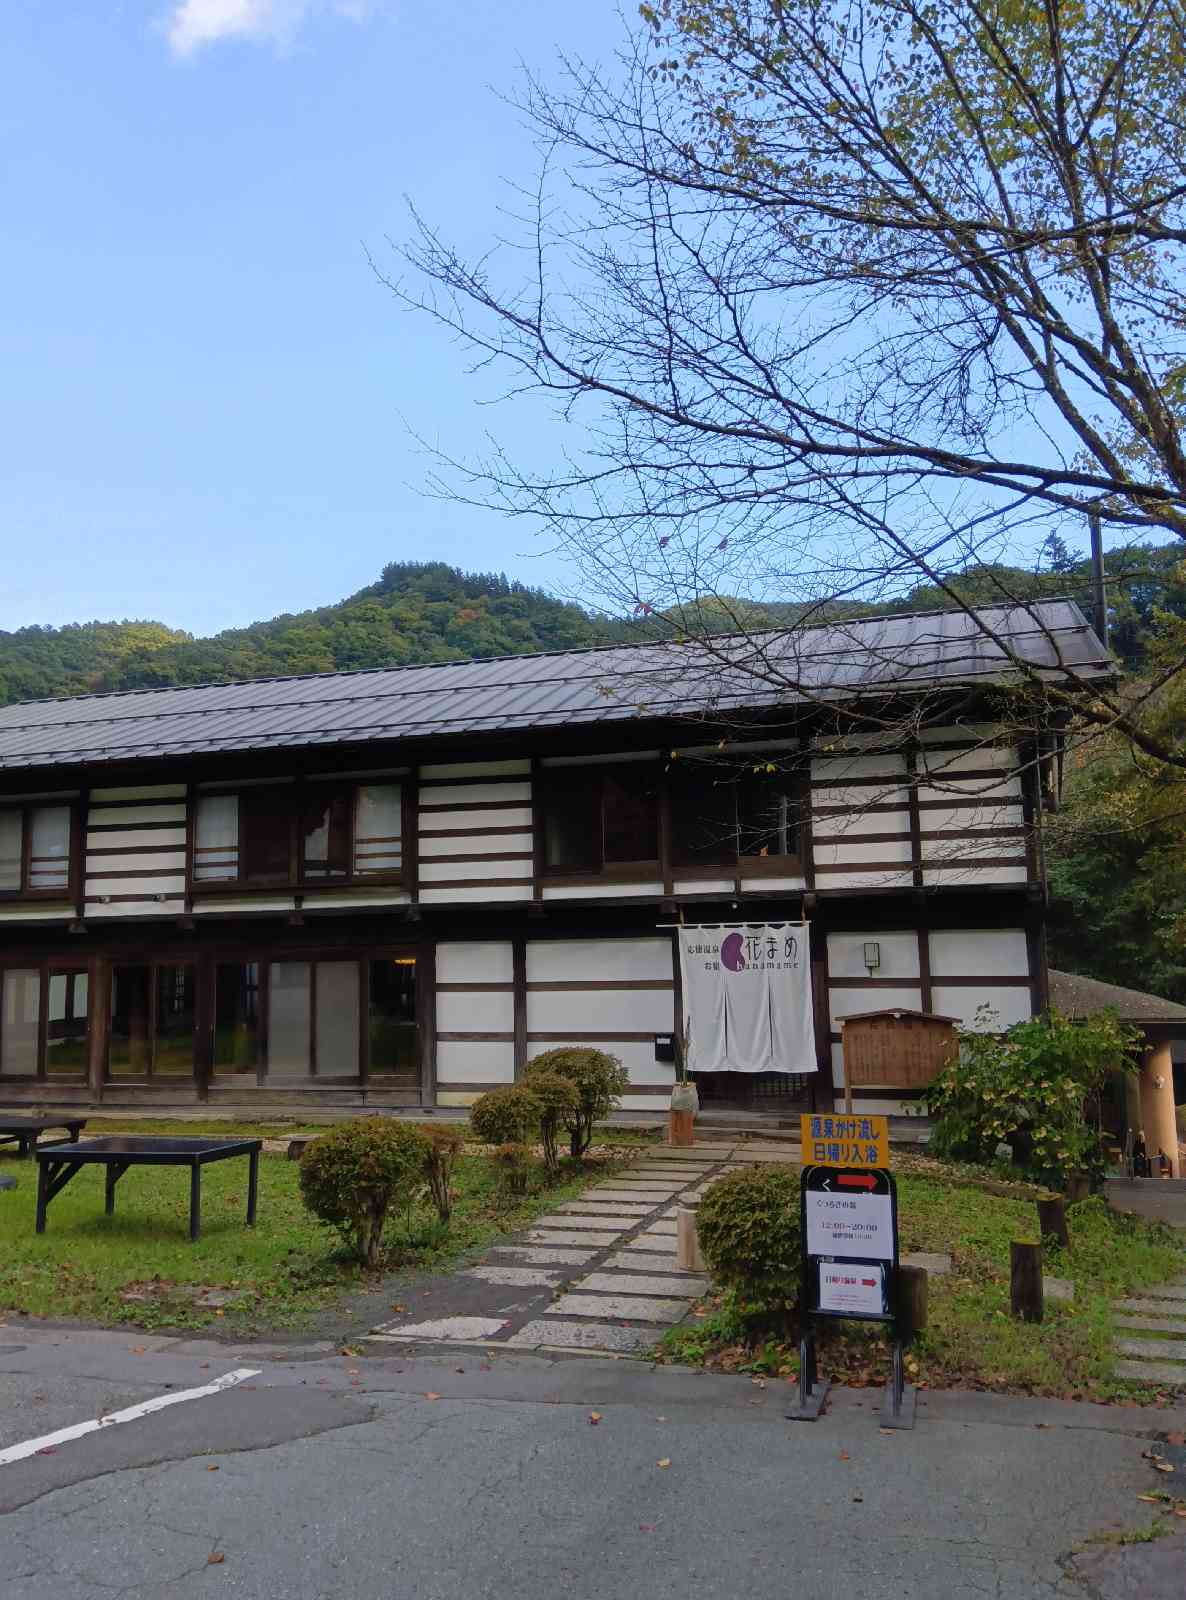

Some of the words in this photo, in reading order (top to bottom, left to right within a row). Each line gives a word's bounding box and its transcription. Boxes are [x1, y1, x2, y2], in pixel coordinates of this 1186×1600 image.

[744, 935, 798, 961] 花まめ
[811, 1118, 881, 1140] 源泉かけ流し
[814, 1142, 879, 1164] 日帰り入浴
